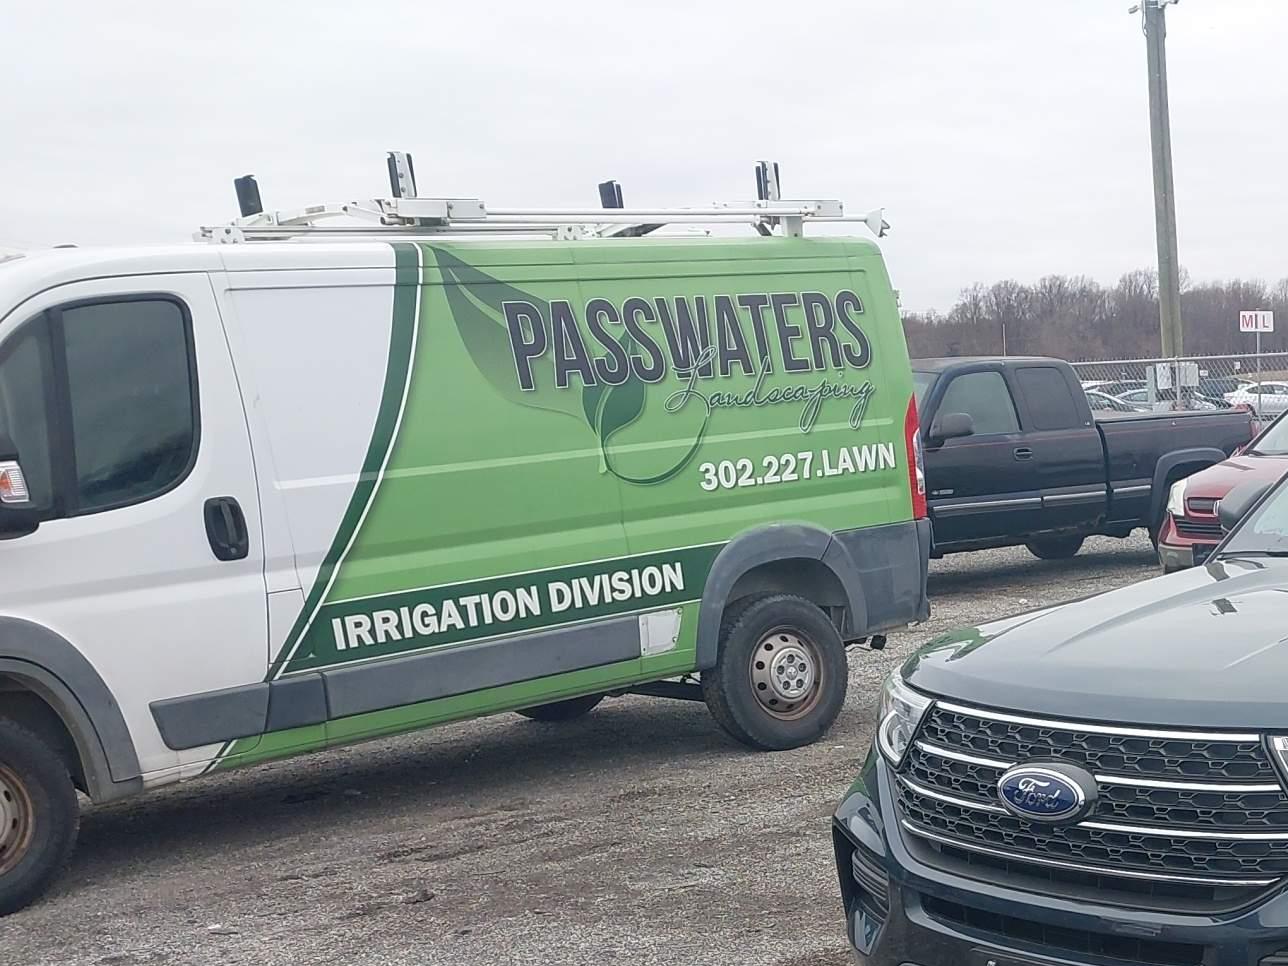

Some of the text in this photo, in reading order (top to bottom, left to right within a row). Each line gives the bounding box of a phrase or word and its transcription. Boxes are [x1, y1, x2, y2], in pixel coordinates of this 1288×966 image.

[502, 289, 872, 391] PASSWATERS
[664, 346, 876, 432] Landscaping
[699, 442, 896, 491] 302.227.LAWN
[331, 562, 685, 651] IRRIGATION DIVISION
[1014, 777, 1061, 809] Ford
